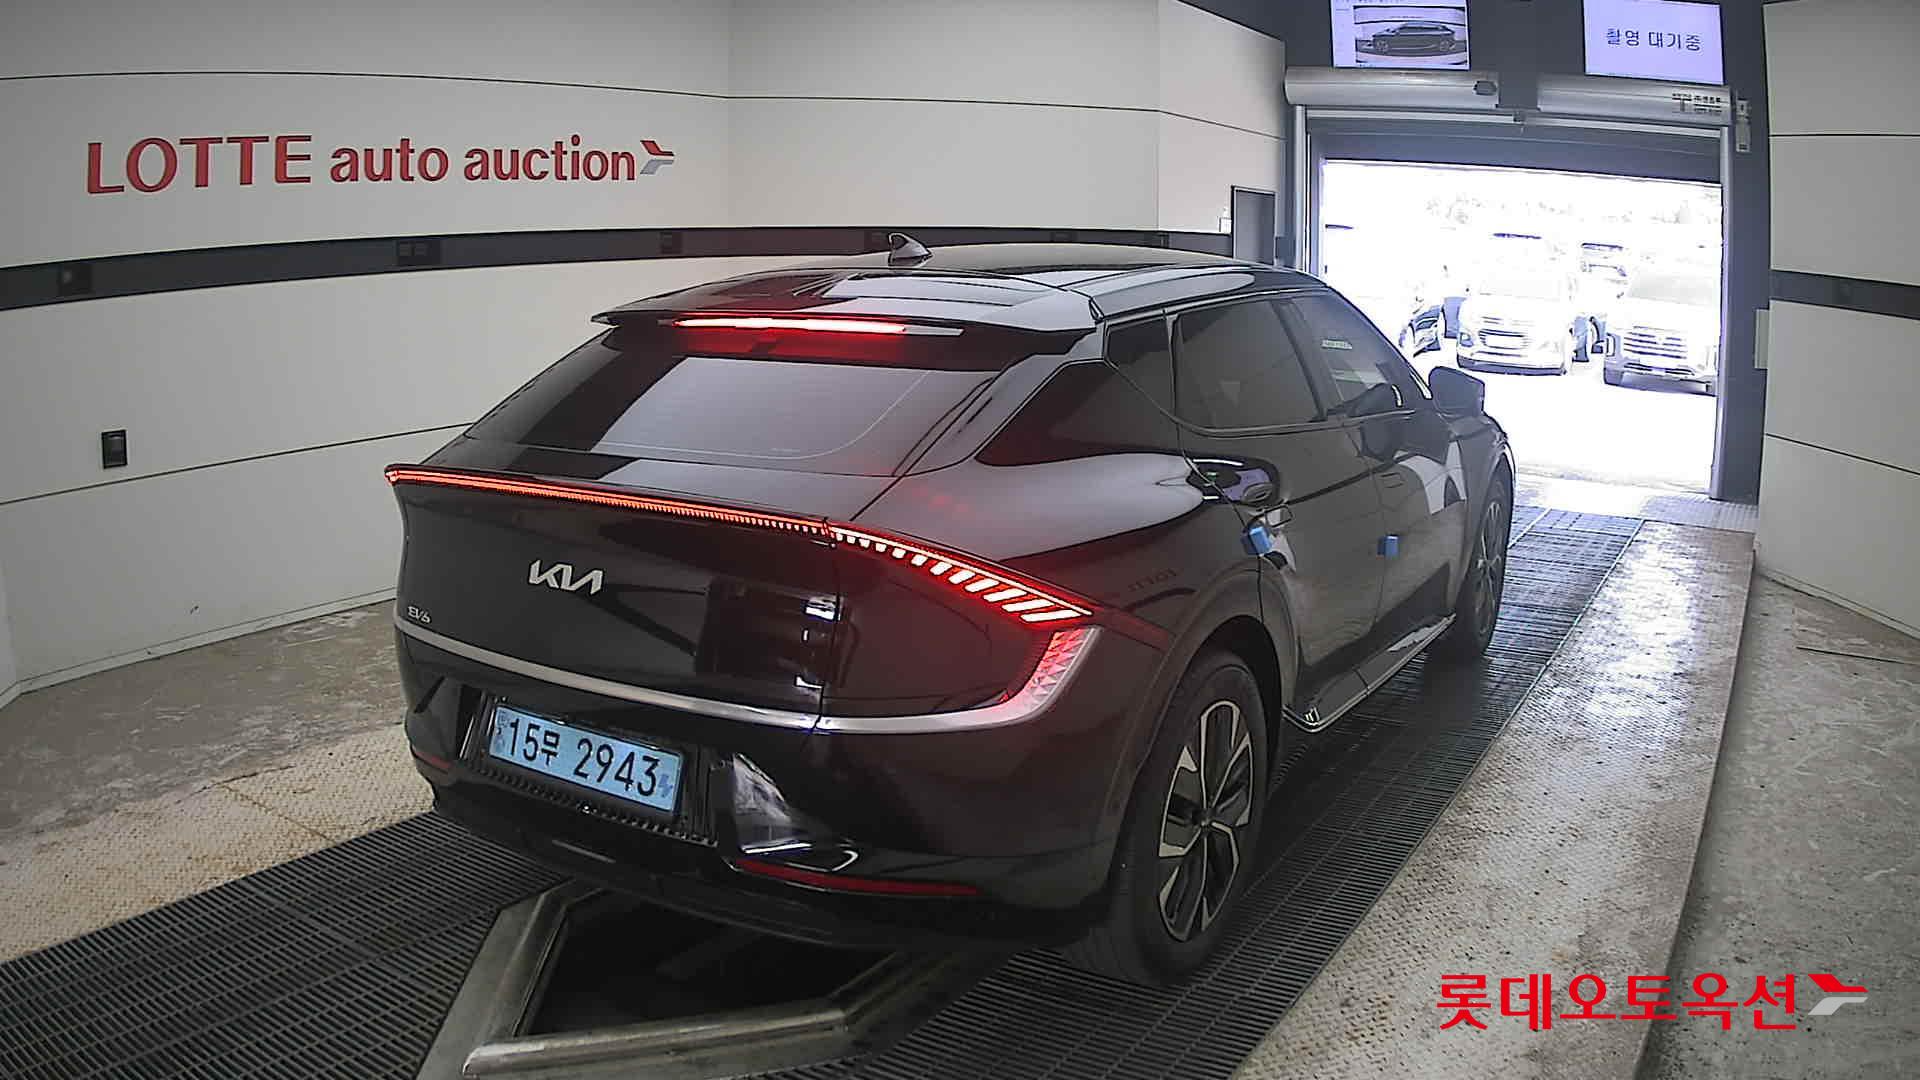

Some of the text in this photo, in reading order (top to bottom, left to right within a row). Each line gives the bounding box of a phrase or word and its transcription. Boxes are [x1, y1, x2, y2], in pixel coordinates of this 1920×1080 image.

[1648, 31, 1700, 51] 대기중
[87, 134, 635, 194] LOTTE auto auction
[529, 560, 603, 595] KIA
[408, 605, 431, 623] EV6
[510, 718, 560, 766] 15무
[573, 738, 660, 796] 2943
